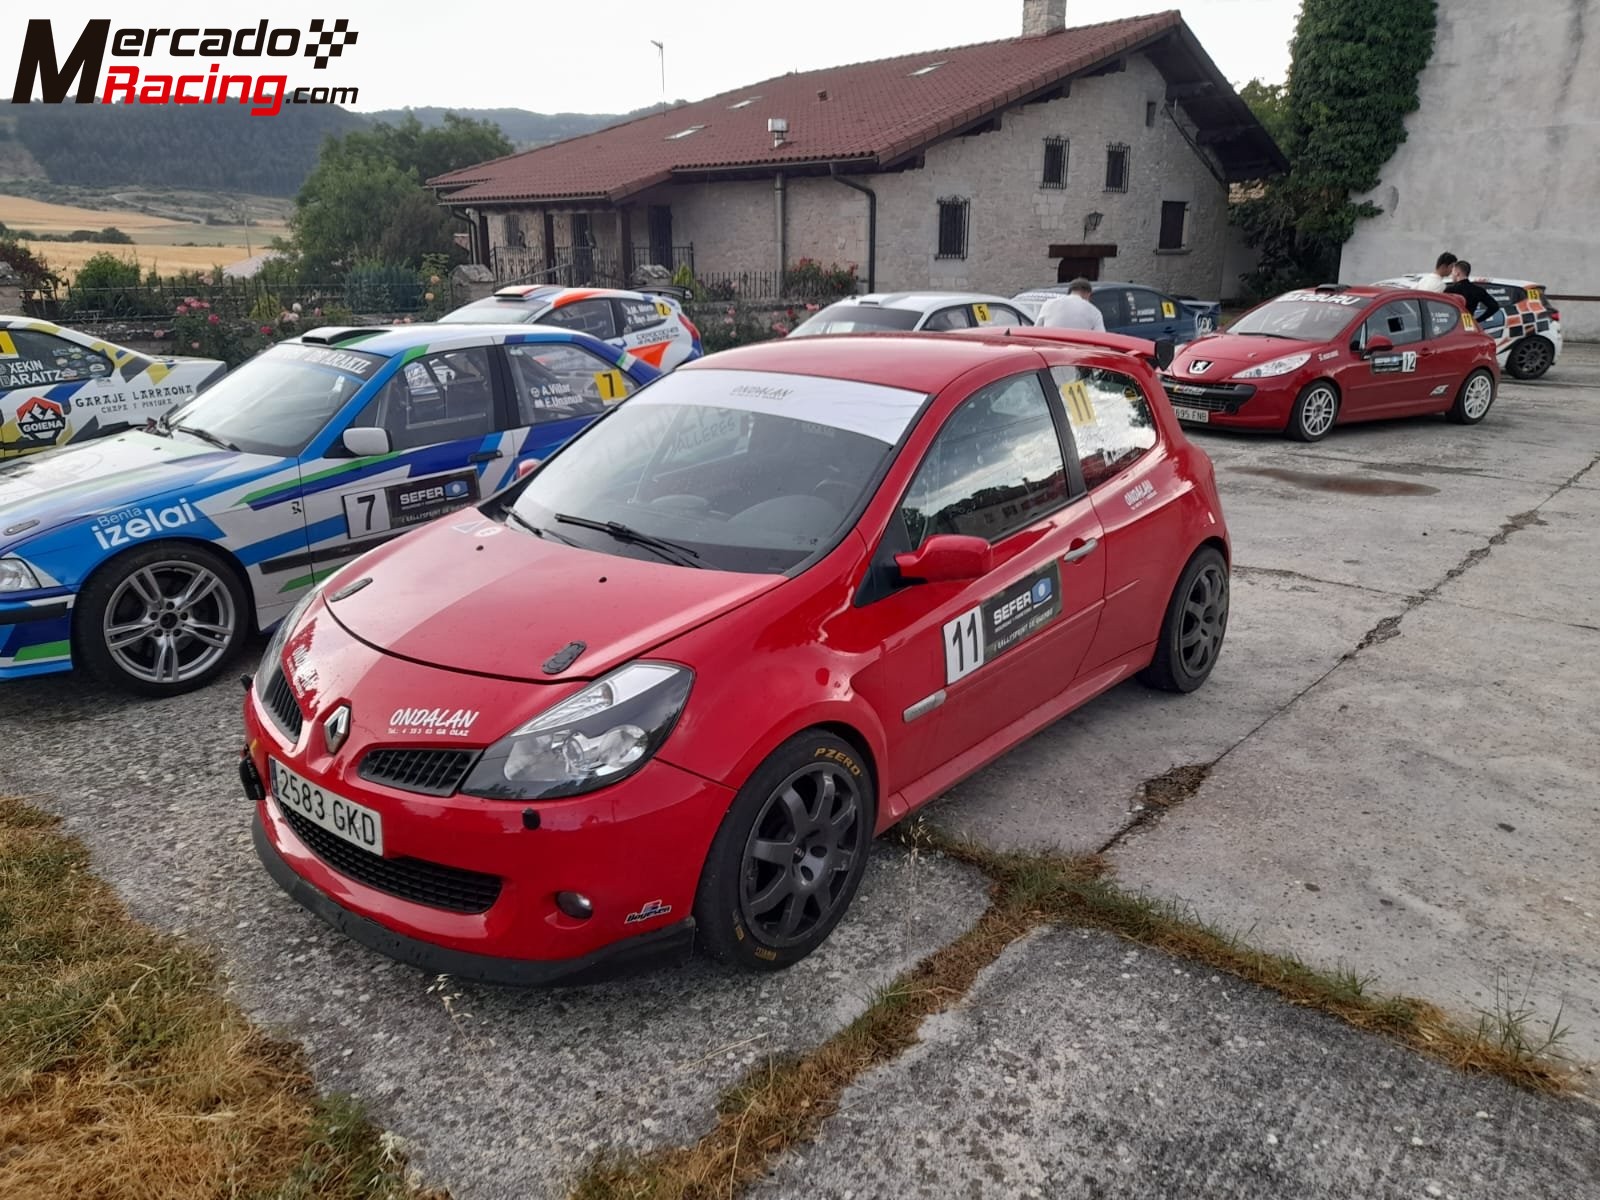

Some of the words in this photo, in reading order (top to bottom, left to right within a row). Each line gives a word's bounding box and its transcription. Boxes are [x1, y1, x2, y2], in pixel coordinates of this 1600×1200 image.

[977, 306, 987, 321] 5
[8, 360, 44, 374] XEKIN
[1403, 353, 1416, 371] 12
[10, 370, 64, 387] ARAITZ
[602, 373, 615, 398] 7
[75, 393, 126, 408] GARAJE
[132, 384, 194, 401] LARRAONA
[142, 398, 173, 408] PINTURA
[1068, 384, 1092, 422] 11
[1175, 408, 1190, 419] 695
[23, 420, 64, 433] GOIENA
[400, 486, 445, 505] SEFER
[97, 507, 143, 527] Benta
[357, 494, 376, 531] 7
[91, 498, 196, 550] izelai
[994, 591, 1032, 625] SEFER
[952, 613, 979, 672] 11
[390, 708, 480, 728] ONDALAN
[815, 748, 861, 776] PZERO
[280, 769, 325, 821] 2583
[333, 800, 375, 846] GKD
